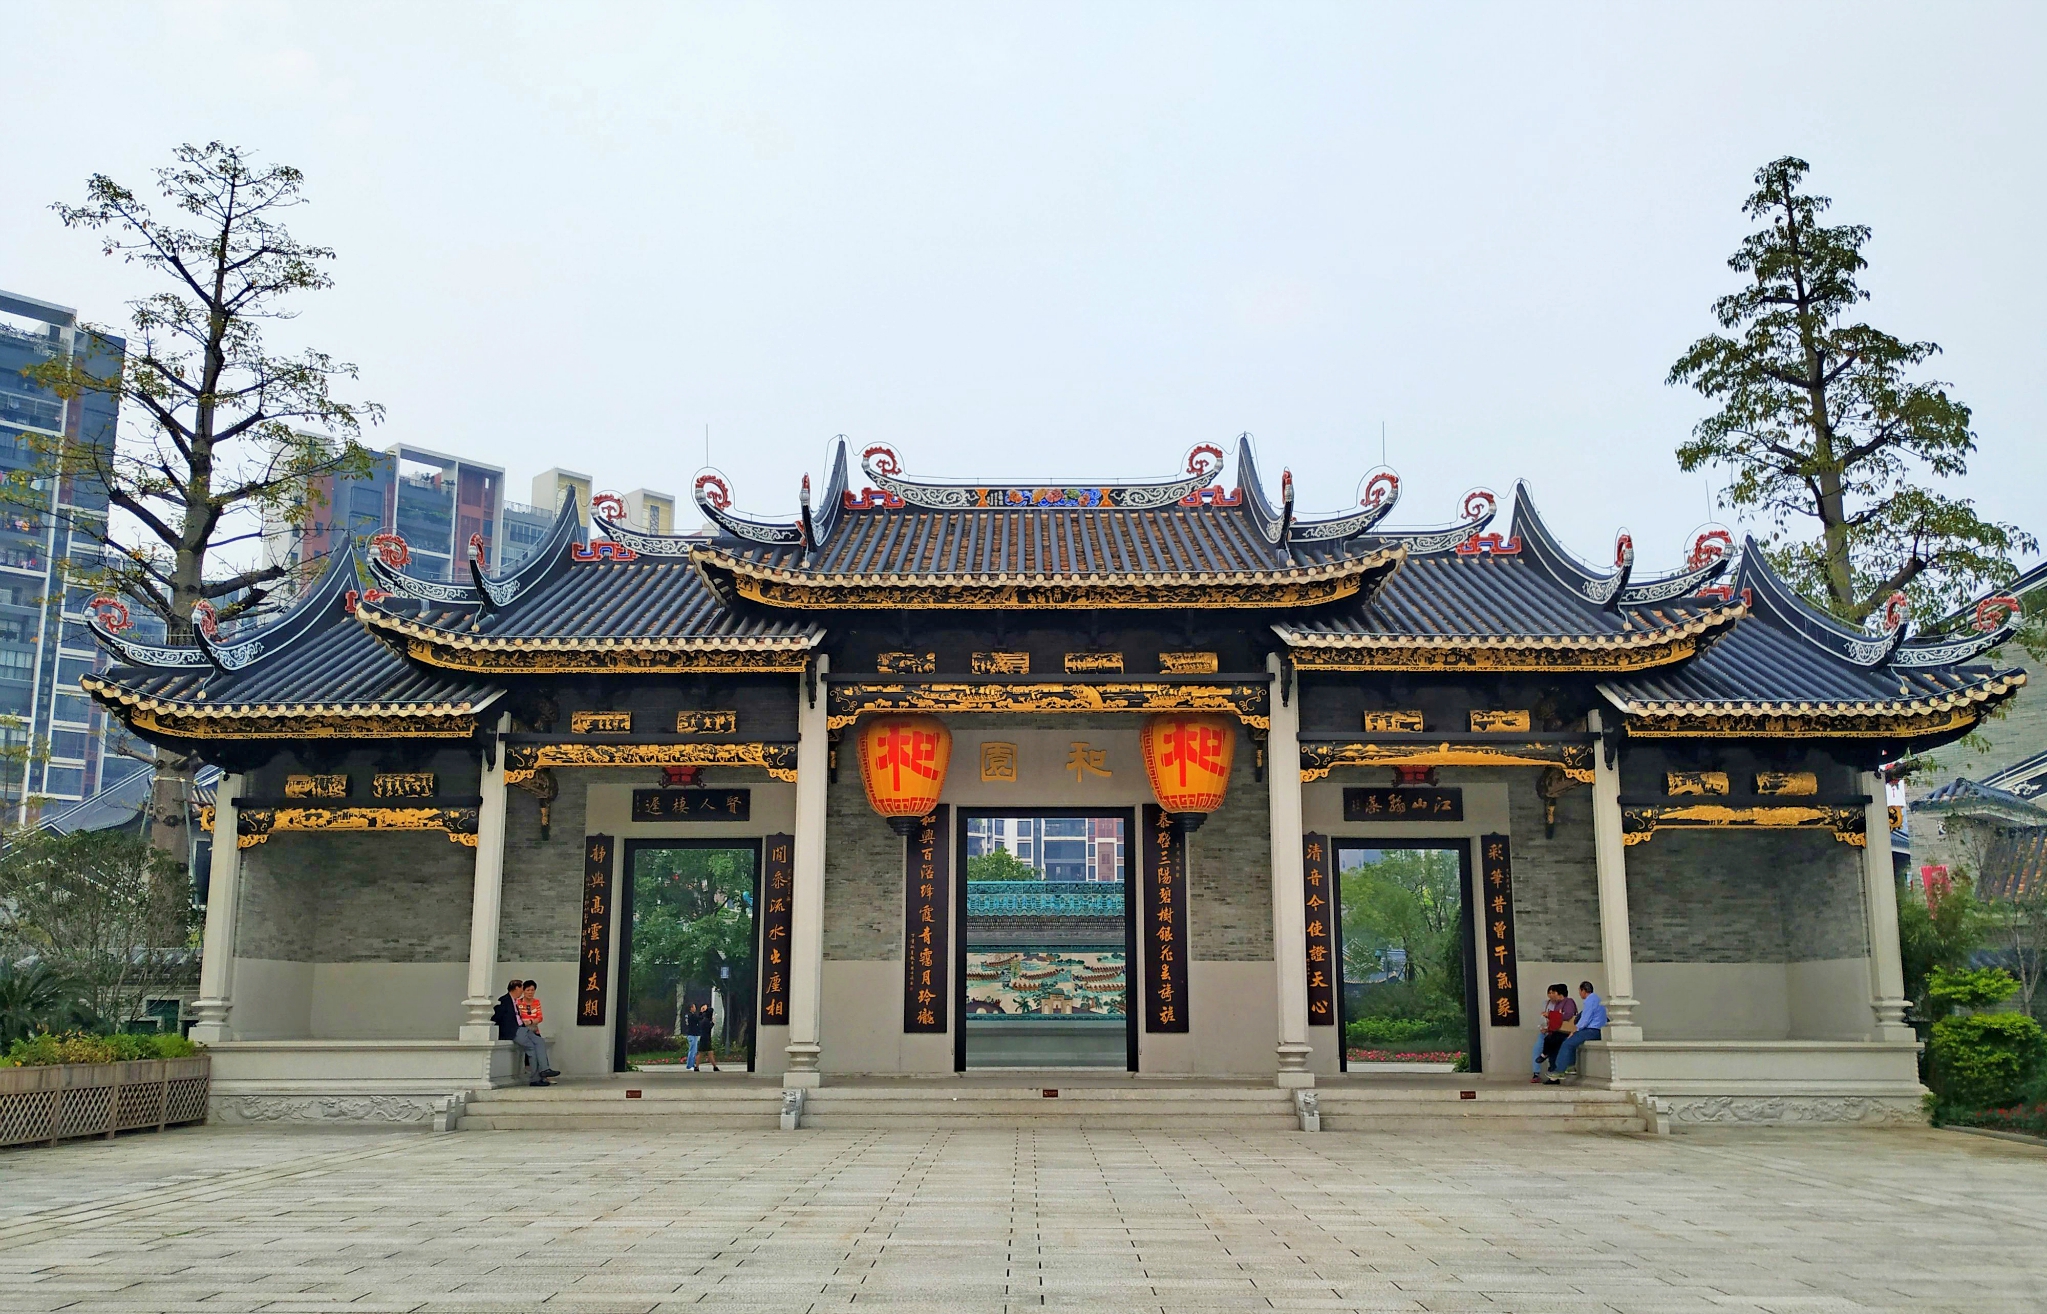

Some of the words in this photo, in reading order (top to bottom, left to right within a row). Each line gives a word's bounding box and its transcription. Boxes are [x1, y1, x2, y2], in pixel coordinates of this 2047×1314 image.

[875, 720, 941, 792] 和
[980, 741, 1113, 783] 和園
[1160, 718, 1226, 788] 和
